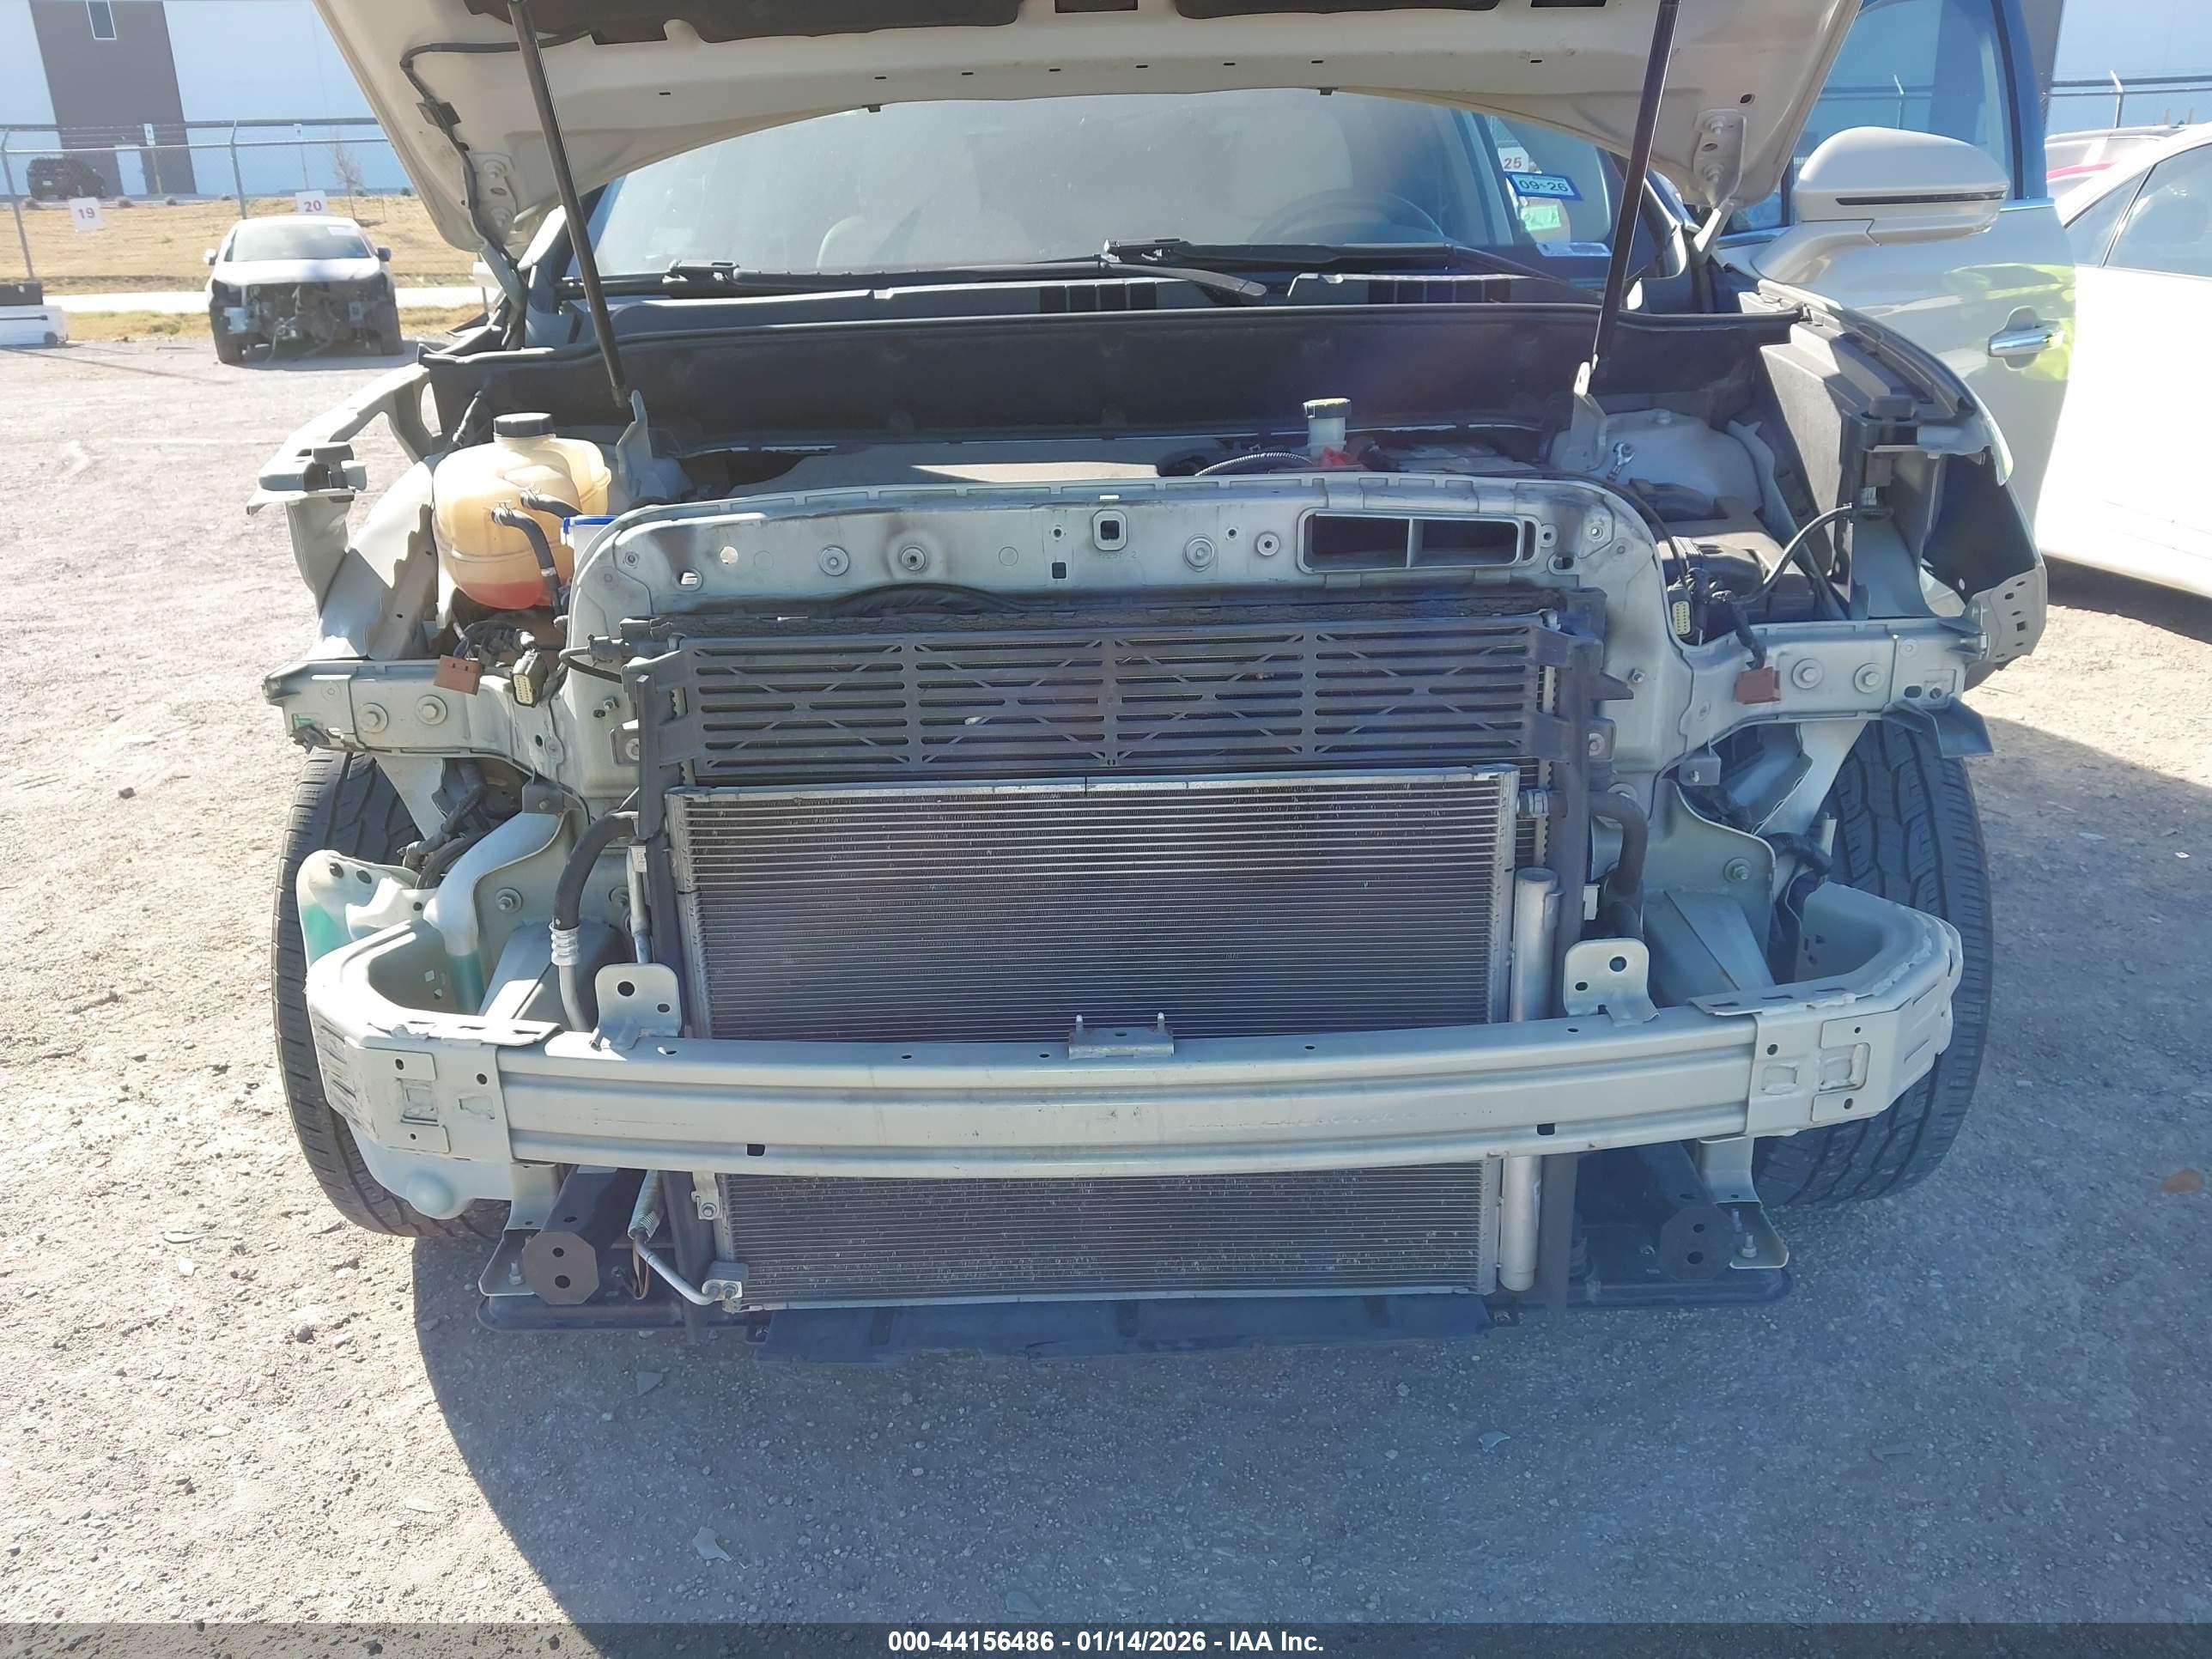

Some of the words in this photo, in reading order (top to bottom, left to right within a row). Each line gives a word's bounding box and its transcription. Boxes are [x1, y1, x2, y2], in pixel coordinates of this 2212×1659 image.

[1504, 157, 1522, 170] 25
[303, 199, 322, 213] 20
[78, 207, 95, 219] 19
